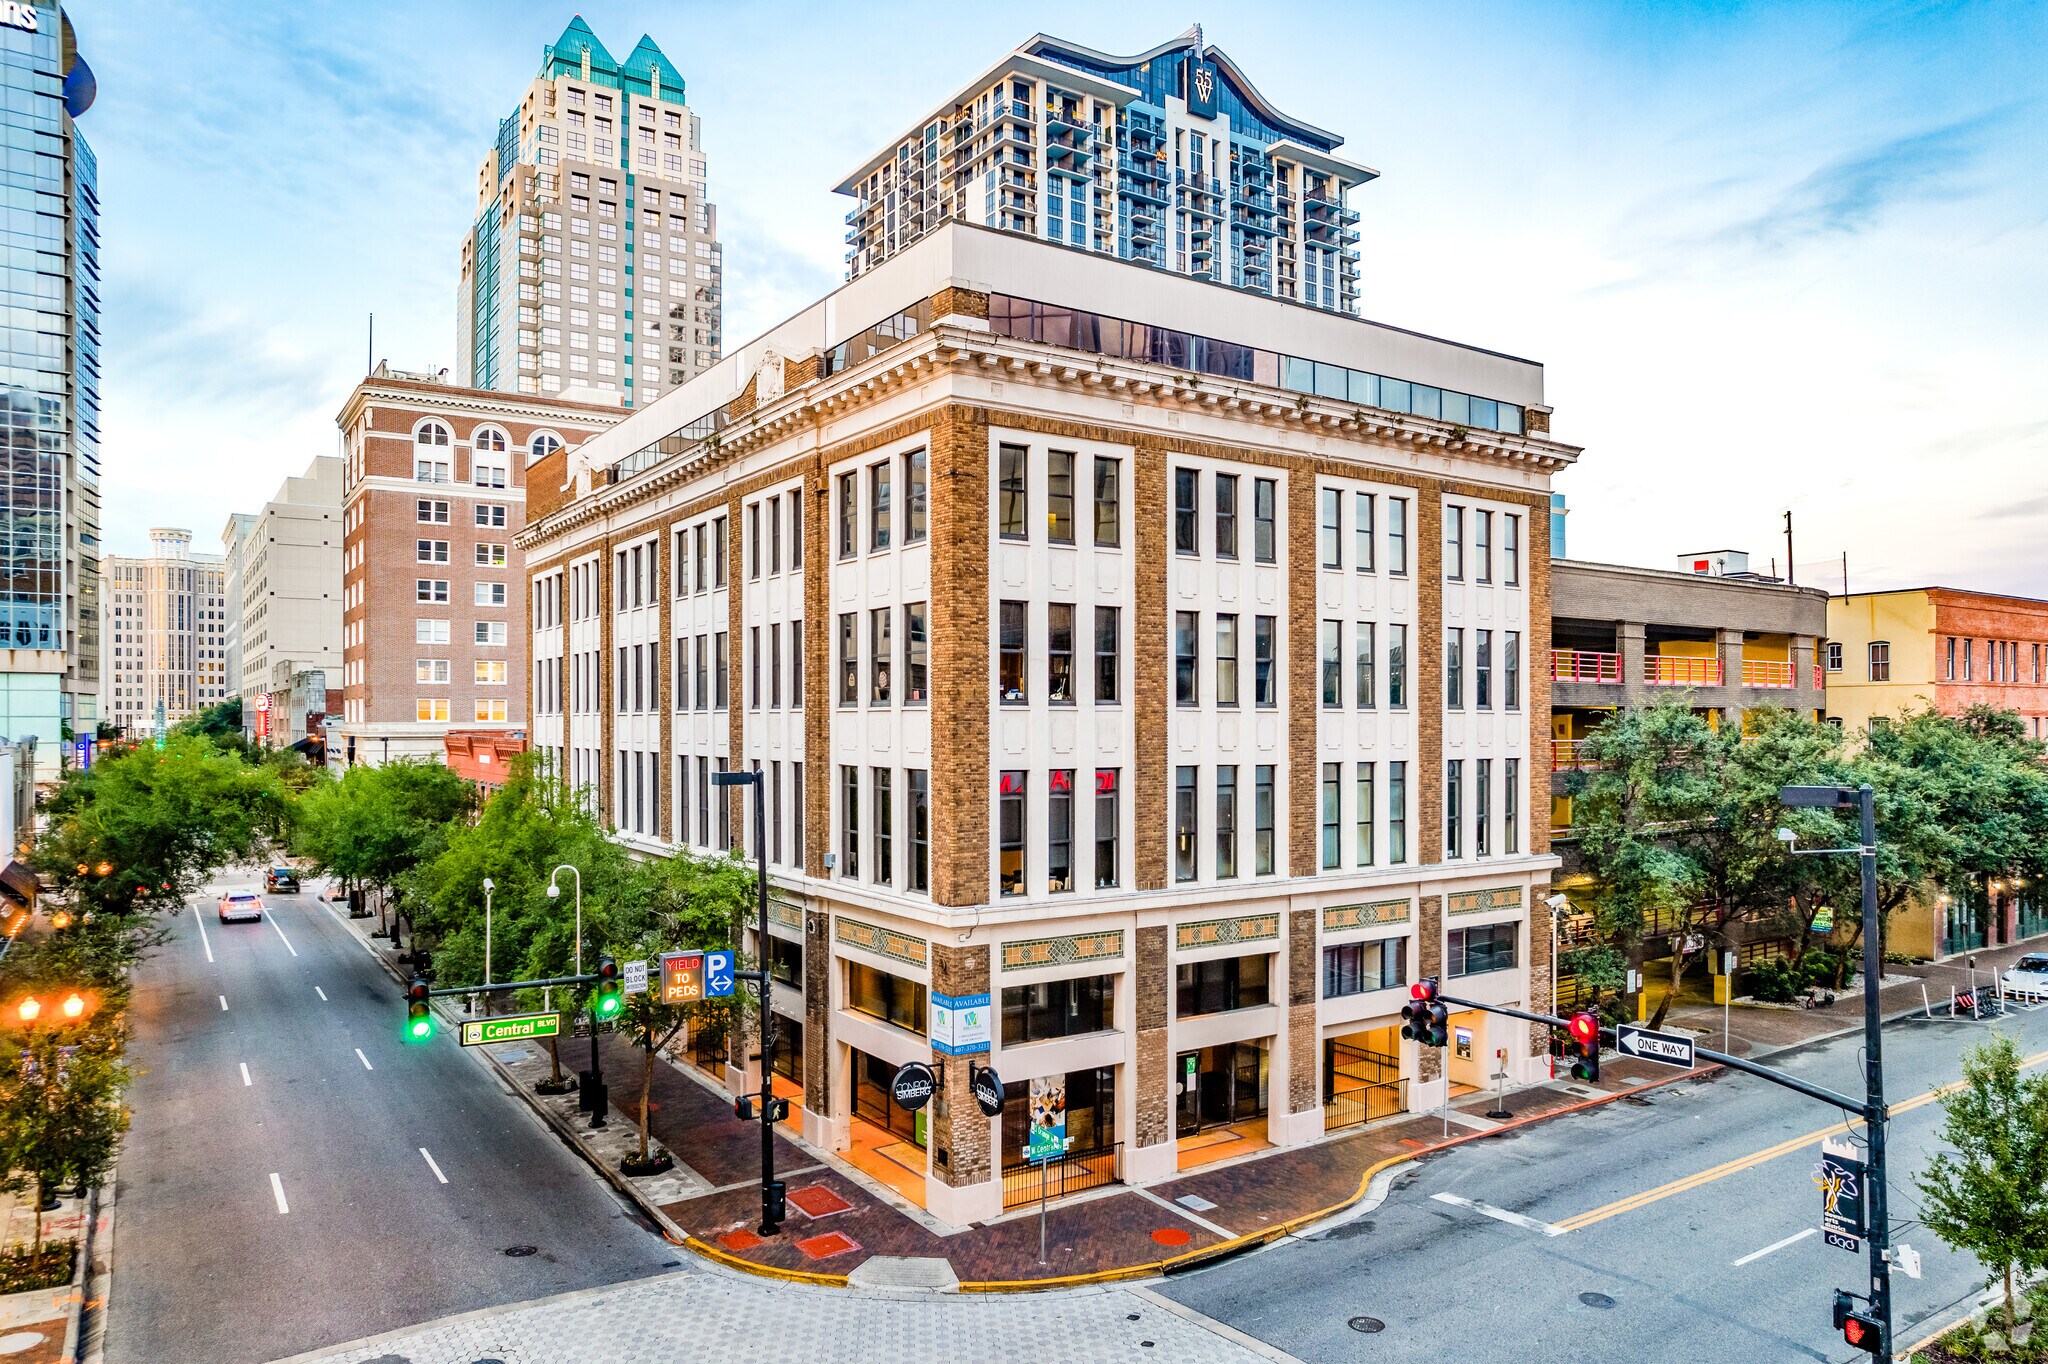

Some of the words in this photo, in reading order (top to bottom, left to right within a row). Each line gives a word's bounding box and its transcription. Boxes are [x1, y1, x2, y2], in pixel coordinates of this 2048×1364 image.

[1195, 68, 1213, 88] 55
[1195, 82, 1213, 103] W
[625, 966, 633, 974] DO
[635, 965, 645, 973] NOT
[666, 958, 700, 971] YIELD
[707, 954, 727, 979] P
[625, 975, 646, 983] BLOCK
[675, 973, 689, 984] TO
[668, 985, 699, 998] PEDS
[932, 994, 953, 1008] AVAILABLE
[954, 996, 990, 1009] AVAILABLE
[486, 1022, 535, 1038] Central
[537, 1019, 556, 1028] BLVD
[1637, 1038, 1659, 1053] ONE
[1661, 1042, 1685, 1057] WAY
[896, 1080, 931, 1092] CONROY
[896, 1086, 932, 1100] SIMBERG
[976, 1083, 998, 1099] CONROY
[976, 1090, 999, 1108] SIMBERG
